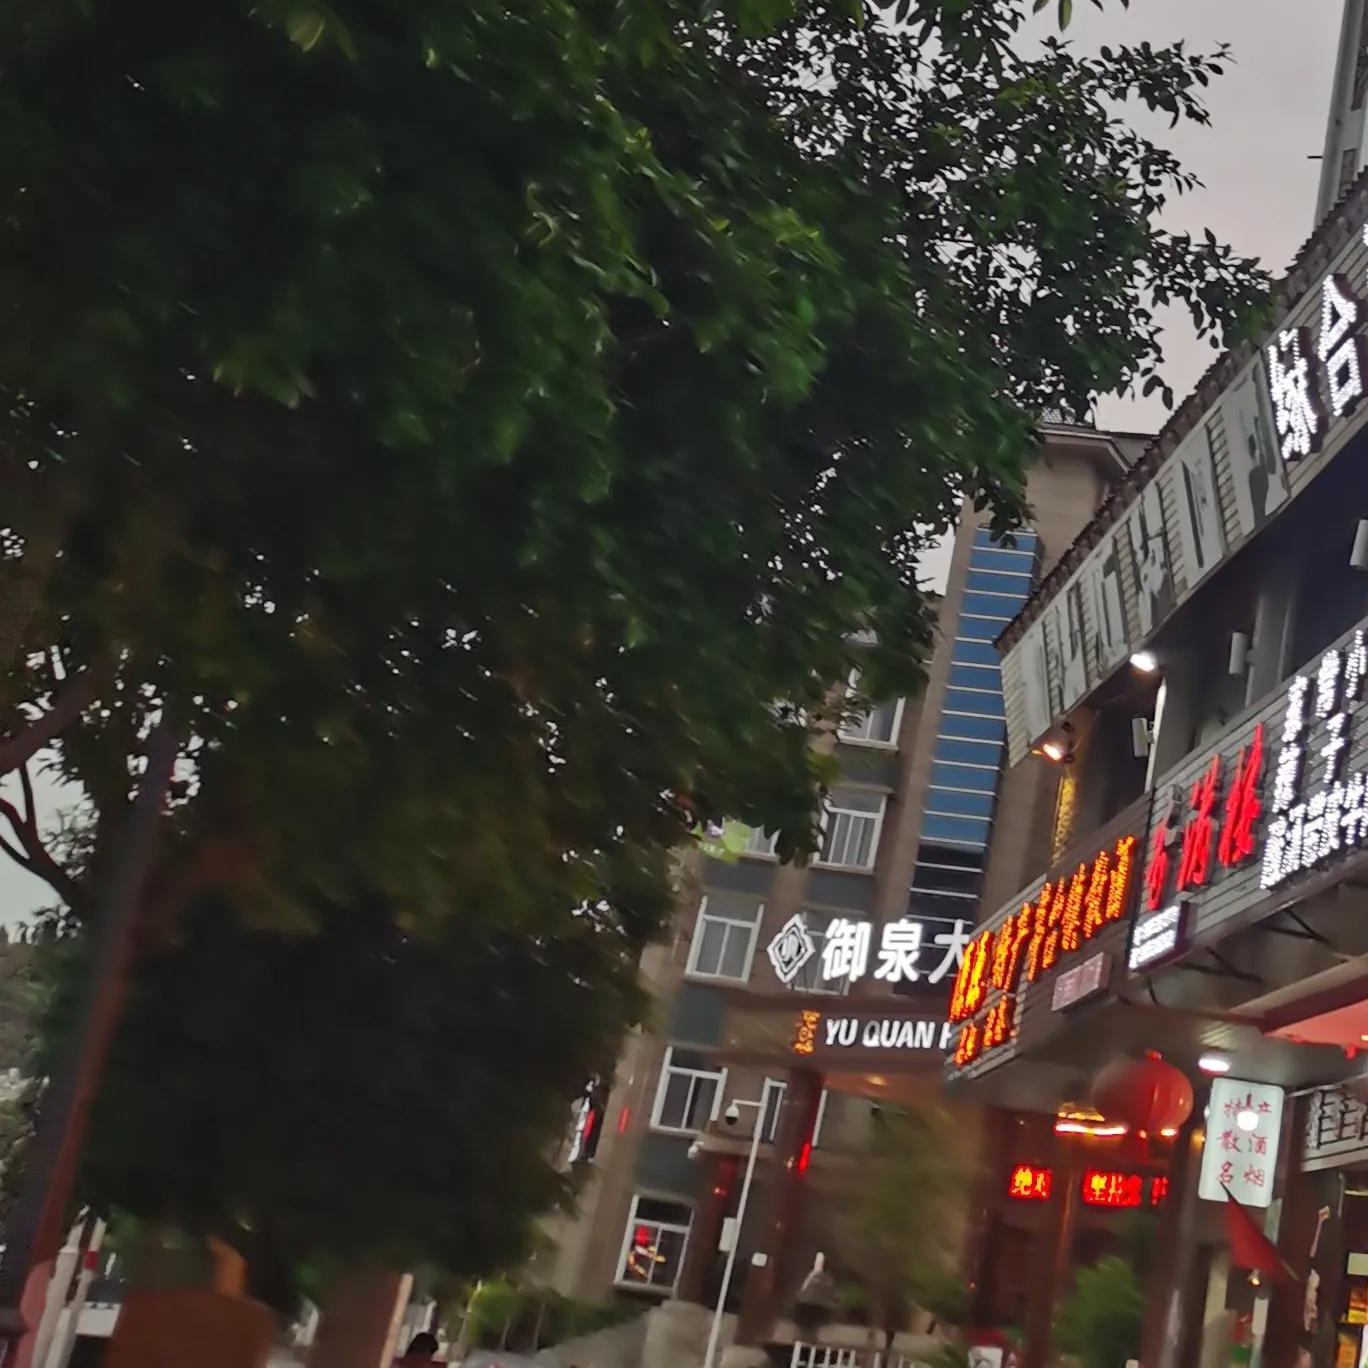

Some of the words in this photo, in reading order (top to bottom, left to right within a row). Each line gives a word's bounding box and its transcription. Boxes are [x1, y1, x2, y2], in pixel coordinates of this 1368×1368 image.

[825, 1018, 858, 1045] YU
[862, 1019, 935, 1049] QUAN
[1217, 1130, 1268, 1155] 散酒
[1218, 1159, 1265, 1188] 名烟
